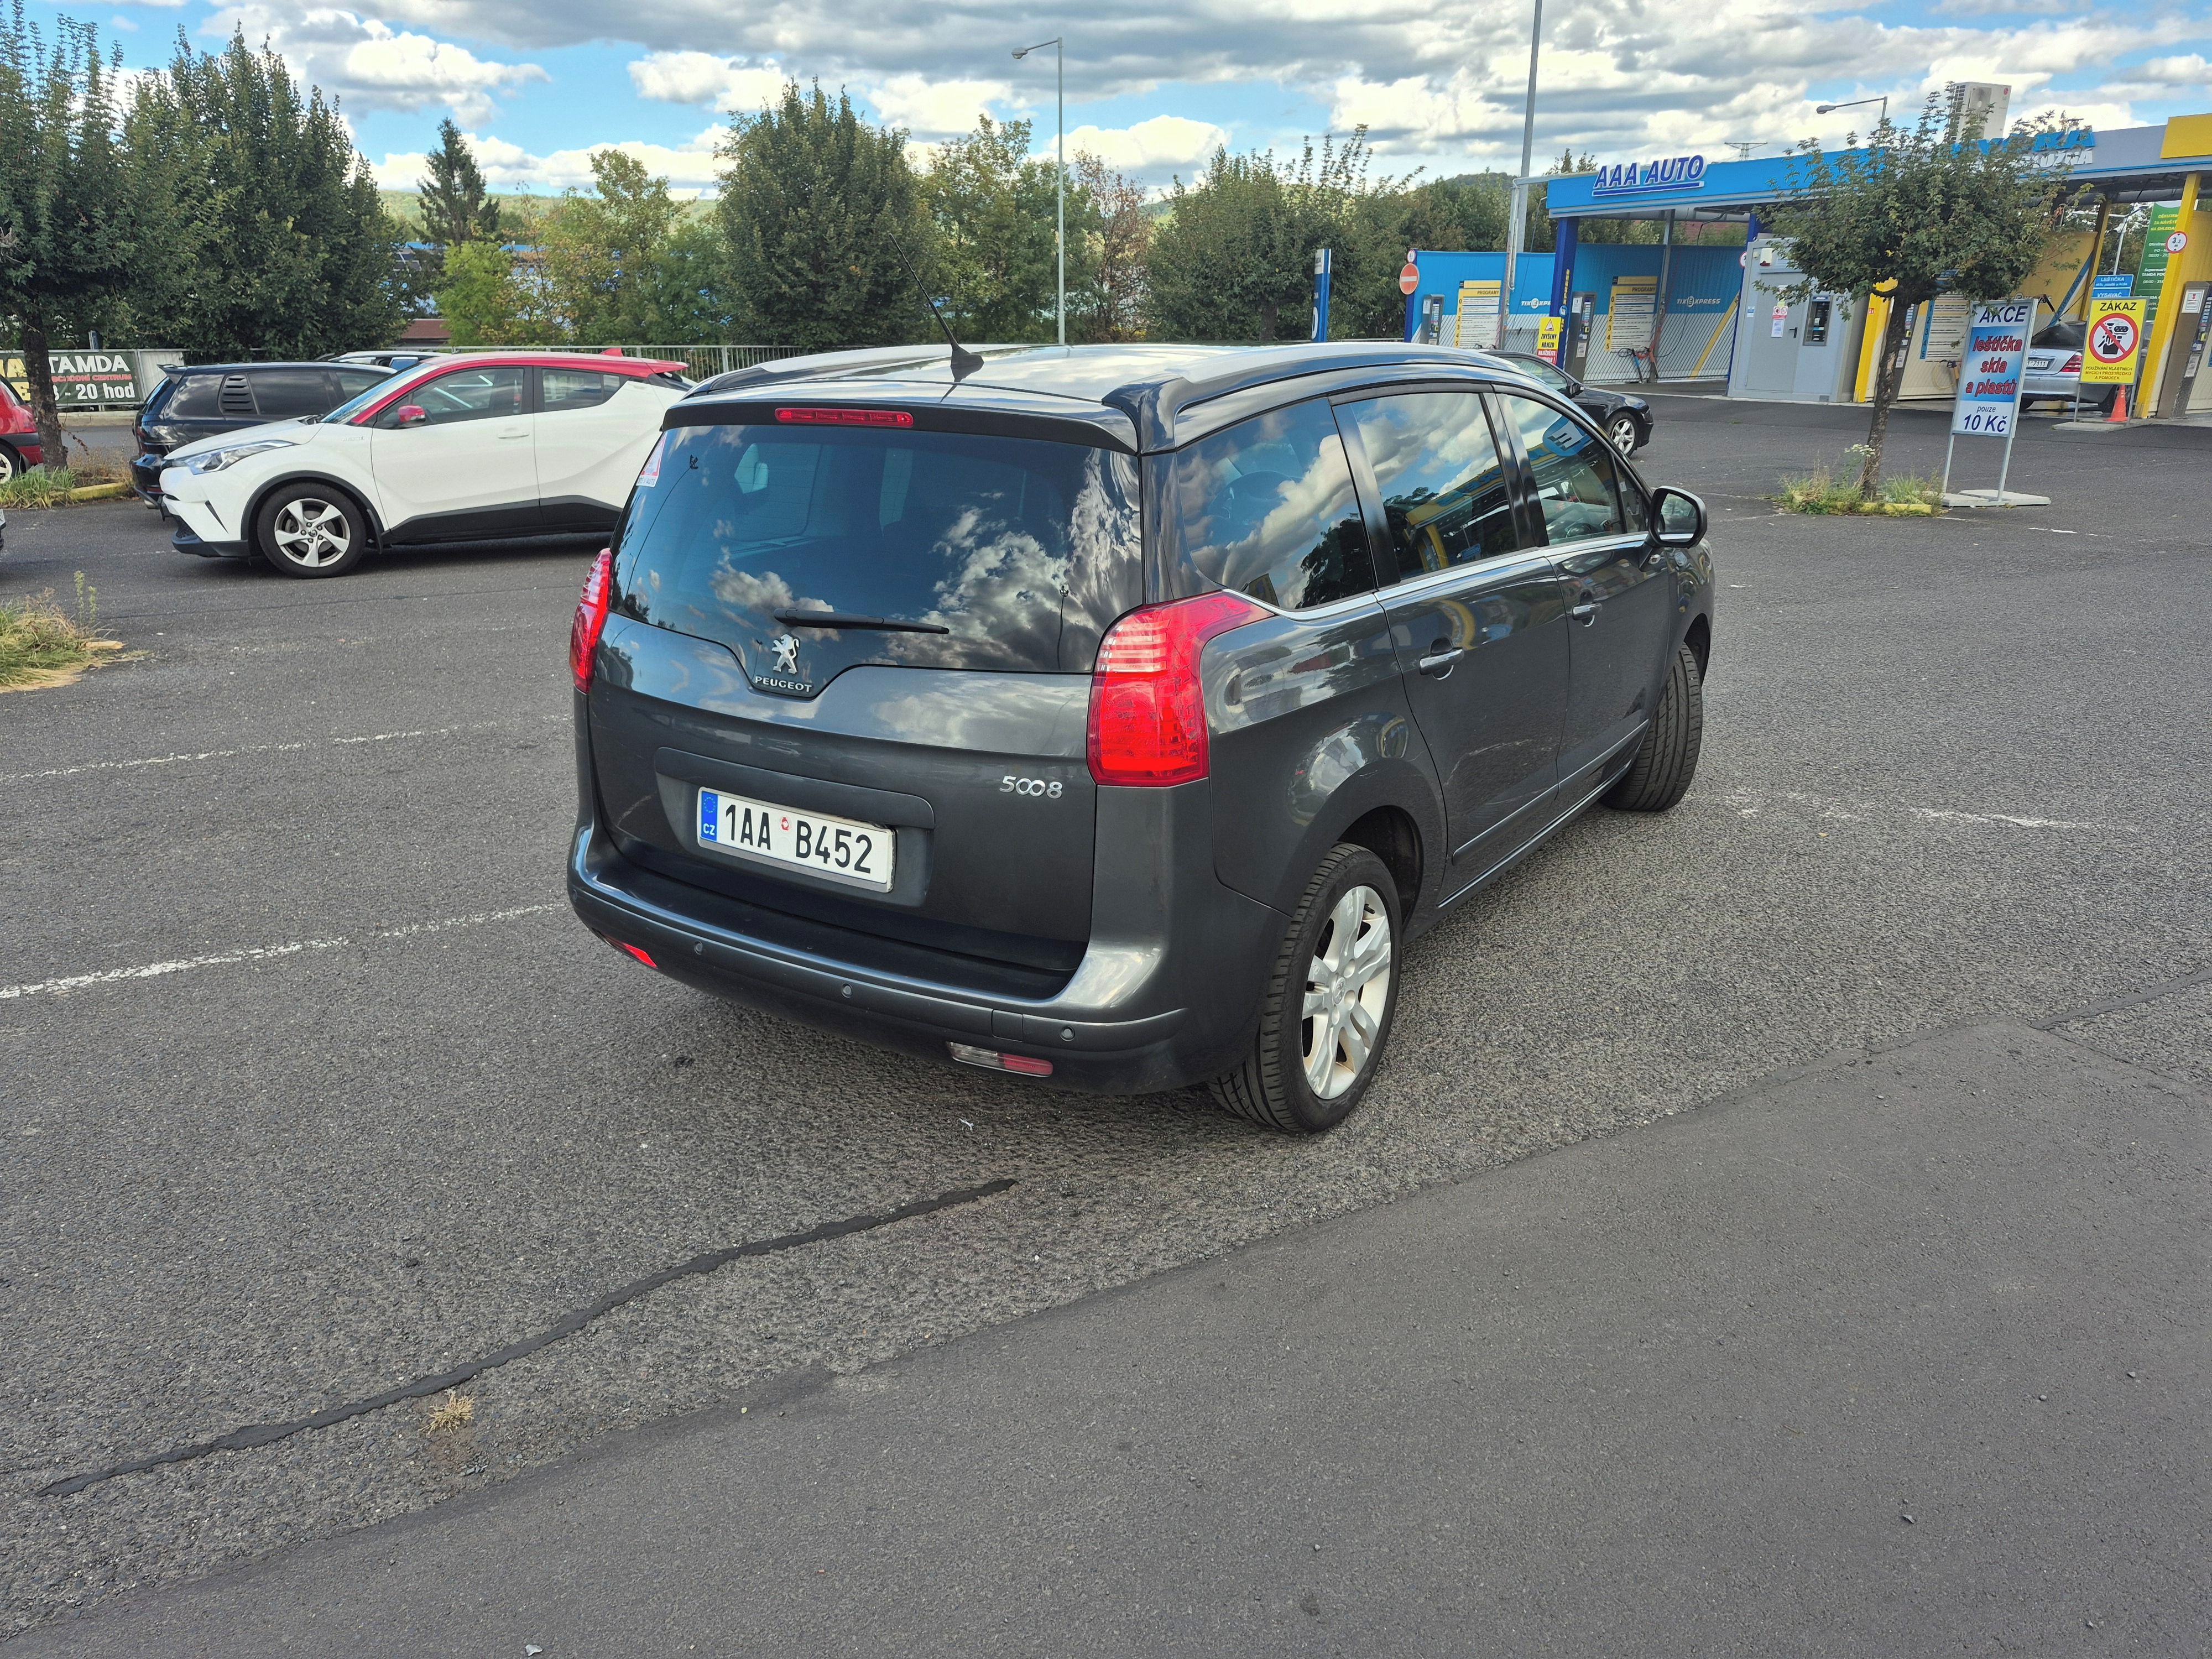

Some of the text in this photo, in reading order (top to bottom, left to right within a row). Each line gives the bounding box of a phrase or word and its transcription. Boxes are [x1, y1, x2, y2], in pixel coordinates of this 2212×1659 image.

[1593, 154, 1706, 189] AAA AUTO
[1979, 305, 2028, 323] AKCE
[2099, 300, 2137, 311] ZÁKAZ
[1972, 335, 2023, 352] leštička
[48, 354, 131, 374] TAMDA
[1980, 357, 2008, 373] skla
[75, 383, 98, 400] 20
[102, 382, 135, 399] hod
[1965, 378, 2017, 397] a plastů
[1976, 405, 1996, 414] pouze
[1964, 414, 2008, 432] 10 Kč
[755, 676, 812, 692] PEUGEOT
[999, 775, 1063, 799] 5008
[703, 804, 873, 874] CZ 1AA B452
